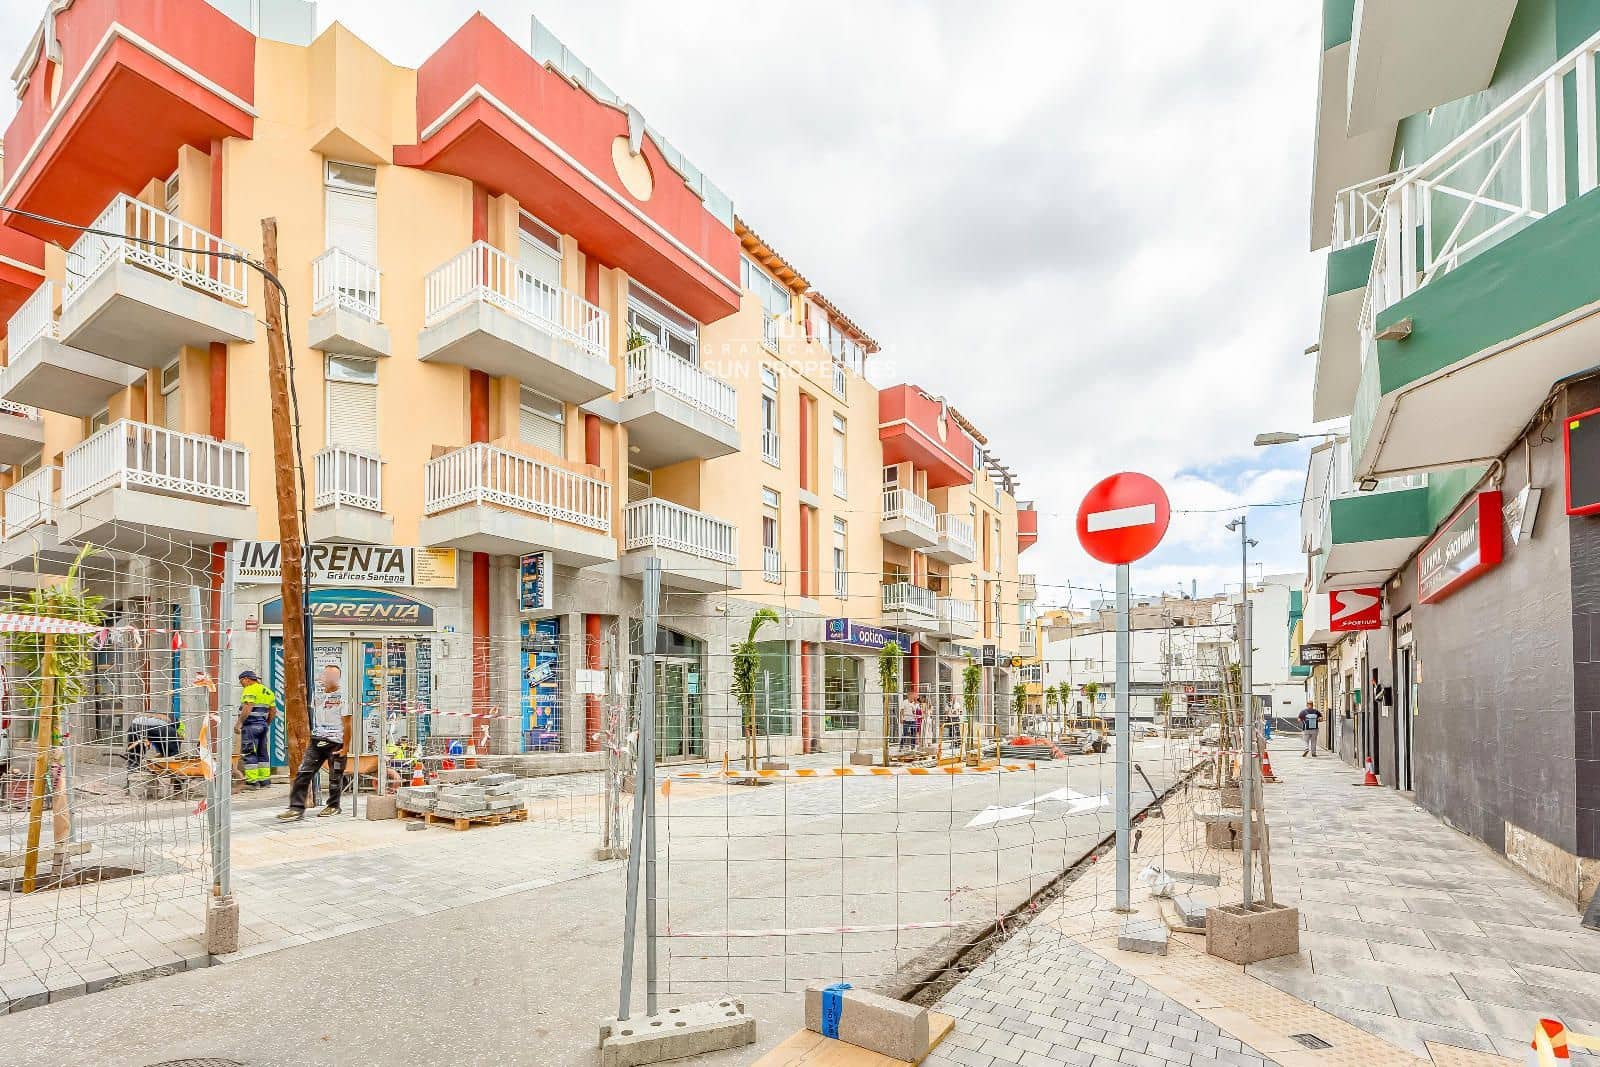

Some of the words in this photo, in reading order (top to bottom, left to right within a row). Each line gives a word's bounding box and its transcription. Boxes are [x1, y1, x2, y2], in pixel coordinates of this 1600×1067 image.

[240, 542, 405, 573] IMRENTA
[367, 572, 405, 582] Santana
[311, 602, 420, 618] PRENTA
